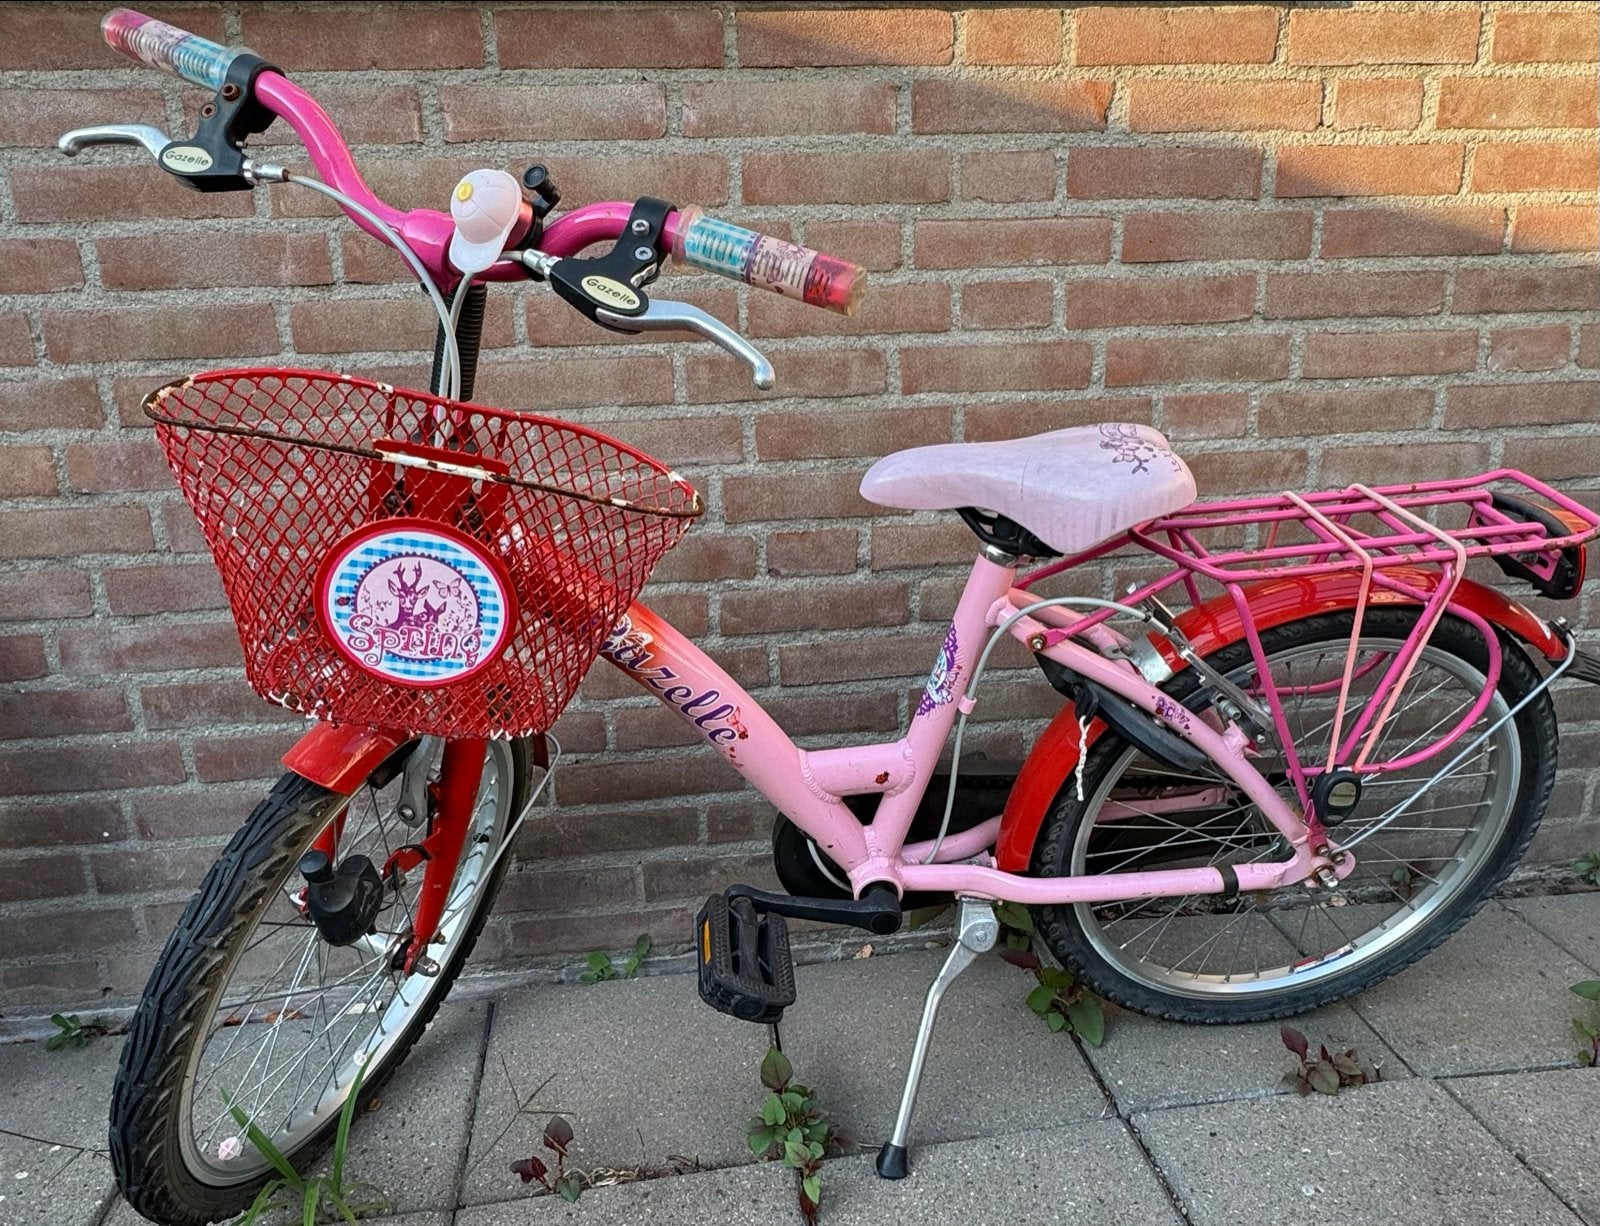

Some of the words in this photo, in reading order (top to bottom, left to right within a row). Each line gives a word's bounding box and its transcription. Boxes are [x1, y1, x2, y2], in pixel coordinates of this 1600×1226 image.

[165, 150, 209, 166] Gazelle
[586, 278, 637, 306] Gazelle
[347, 614, 483, 668] Spring
[600, 632, 737, 746] azelle
